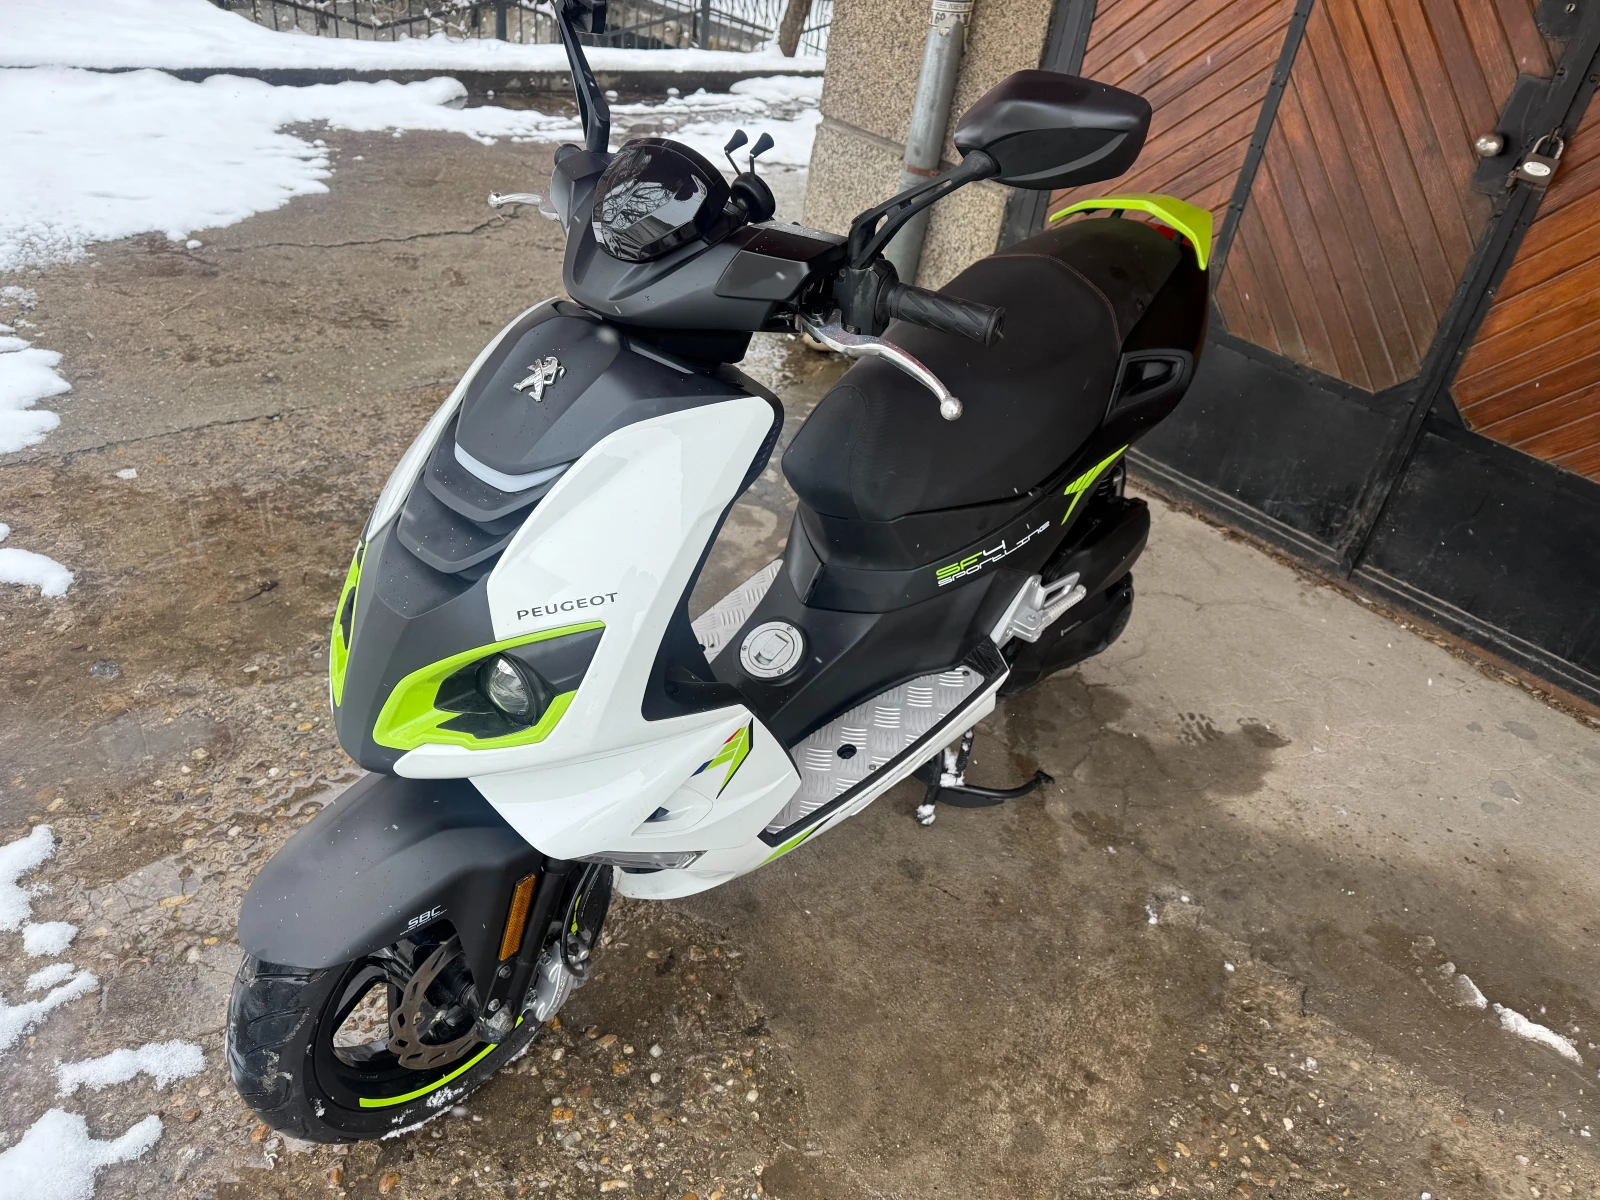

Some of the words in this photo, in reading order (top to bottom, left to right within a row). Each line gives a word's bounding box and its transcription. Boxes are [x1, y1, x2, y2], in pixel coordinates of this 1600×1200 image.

[936, 540, 1006, 580] SF4
[516, 592, 618, 620] PEUGEOT
[408, 904, 442, 930] SBC
